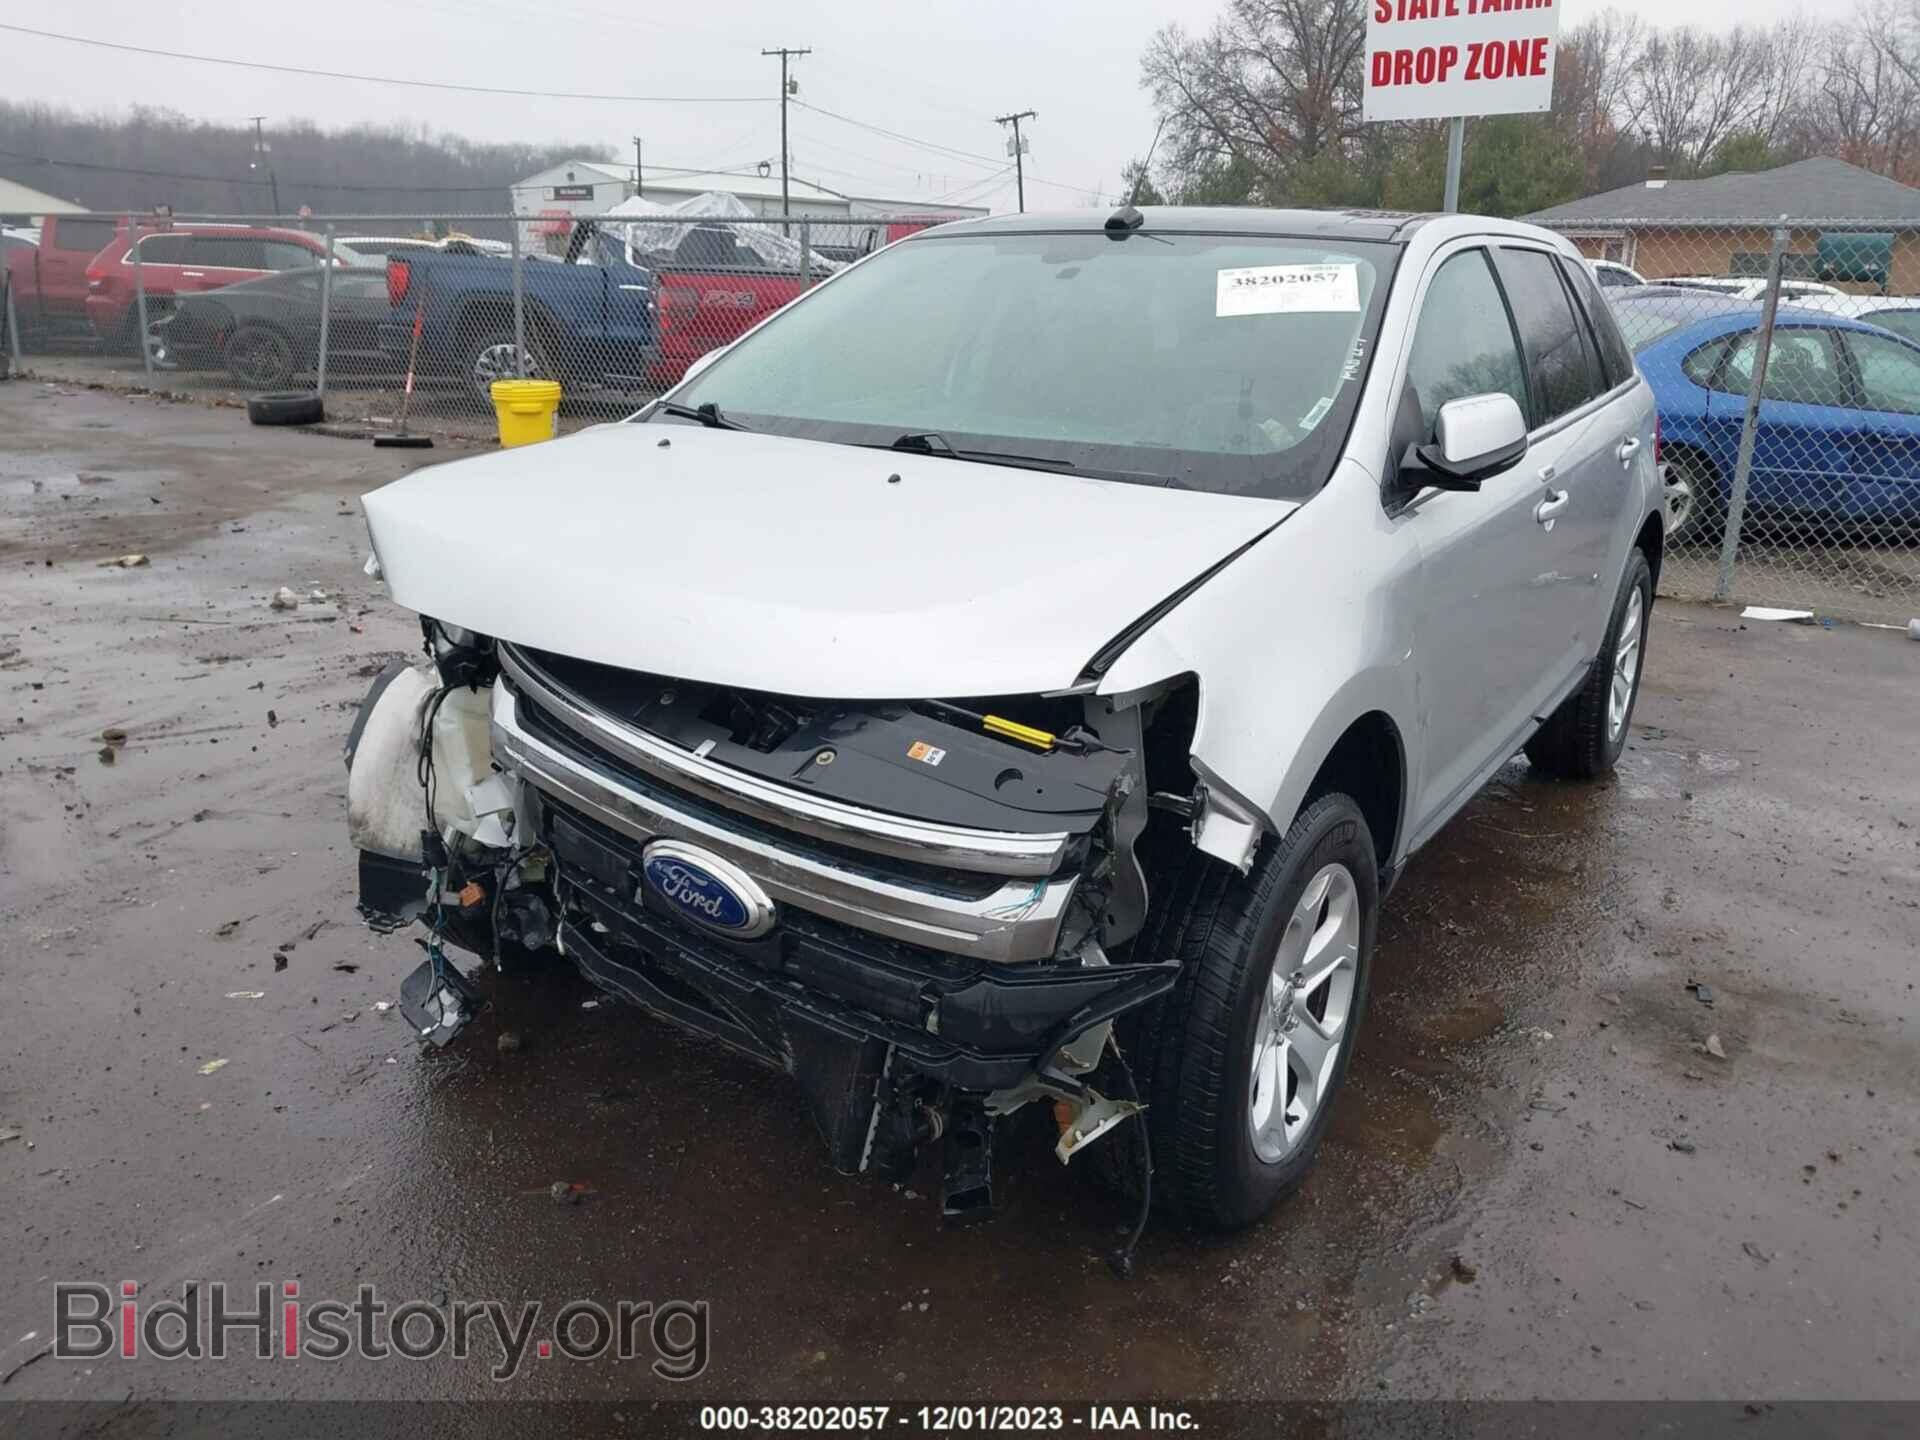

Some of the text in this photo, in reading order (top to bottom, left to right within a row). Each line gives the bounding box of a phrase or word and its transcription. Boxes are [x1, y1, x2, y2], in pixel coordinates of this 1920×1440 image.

[1371, 37, 1549, 87] DROP ZONE
[1232, 272, 1339, 287] 38202057
[663, 865, 723, 918] Ford
